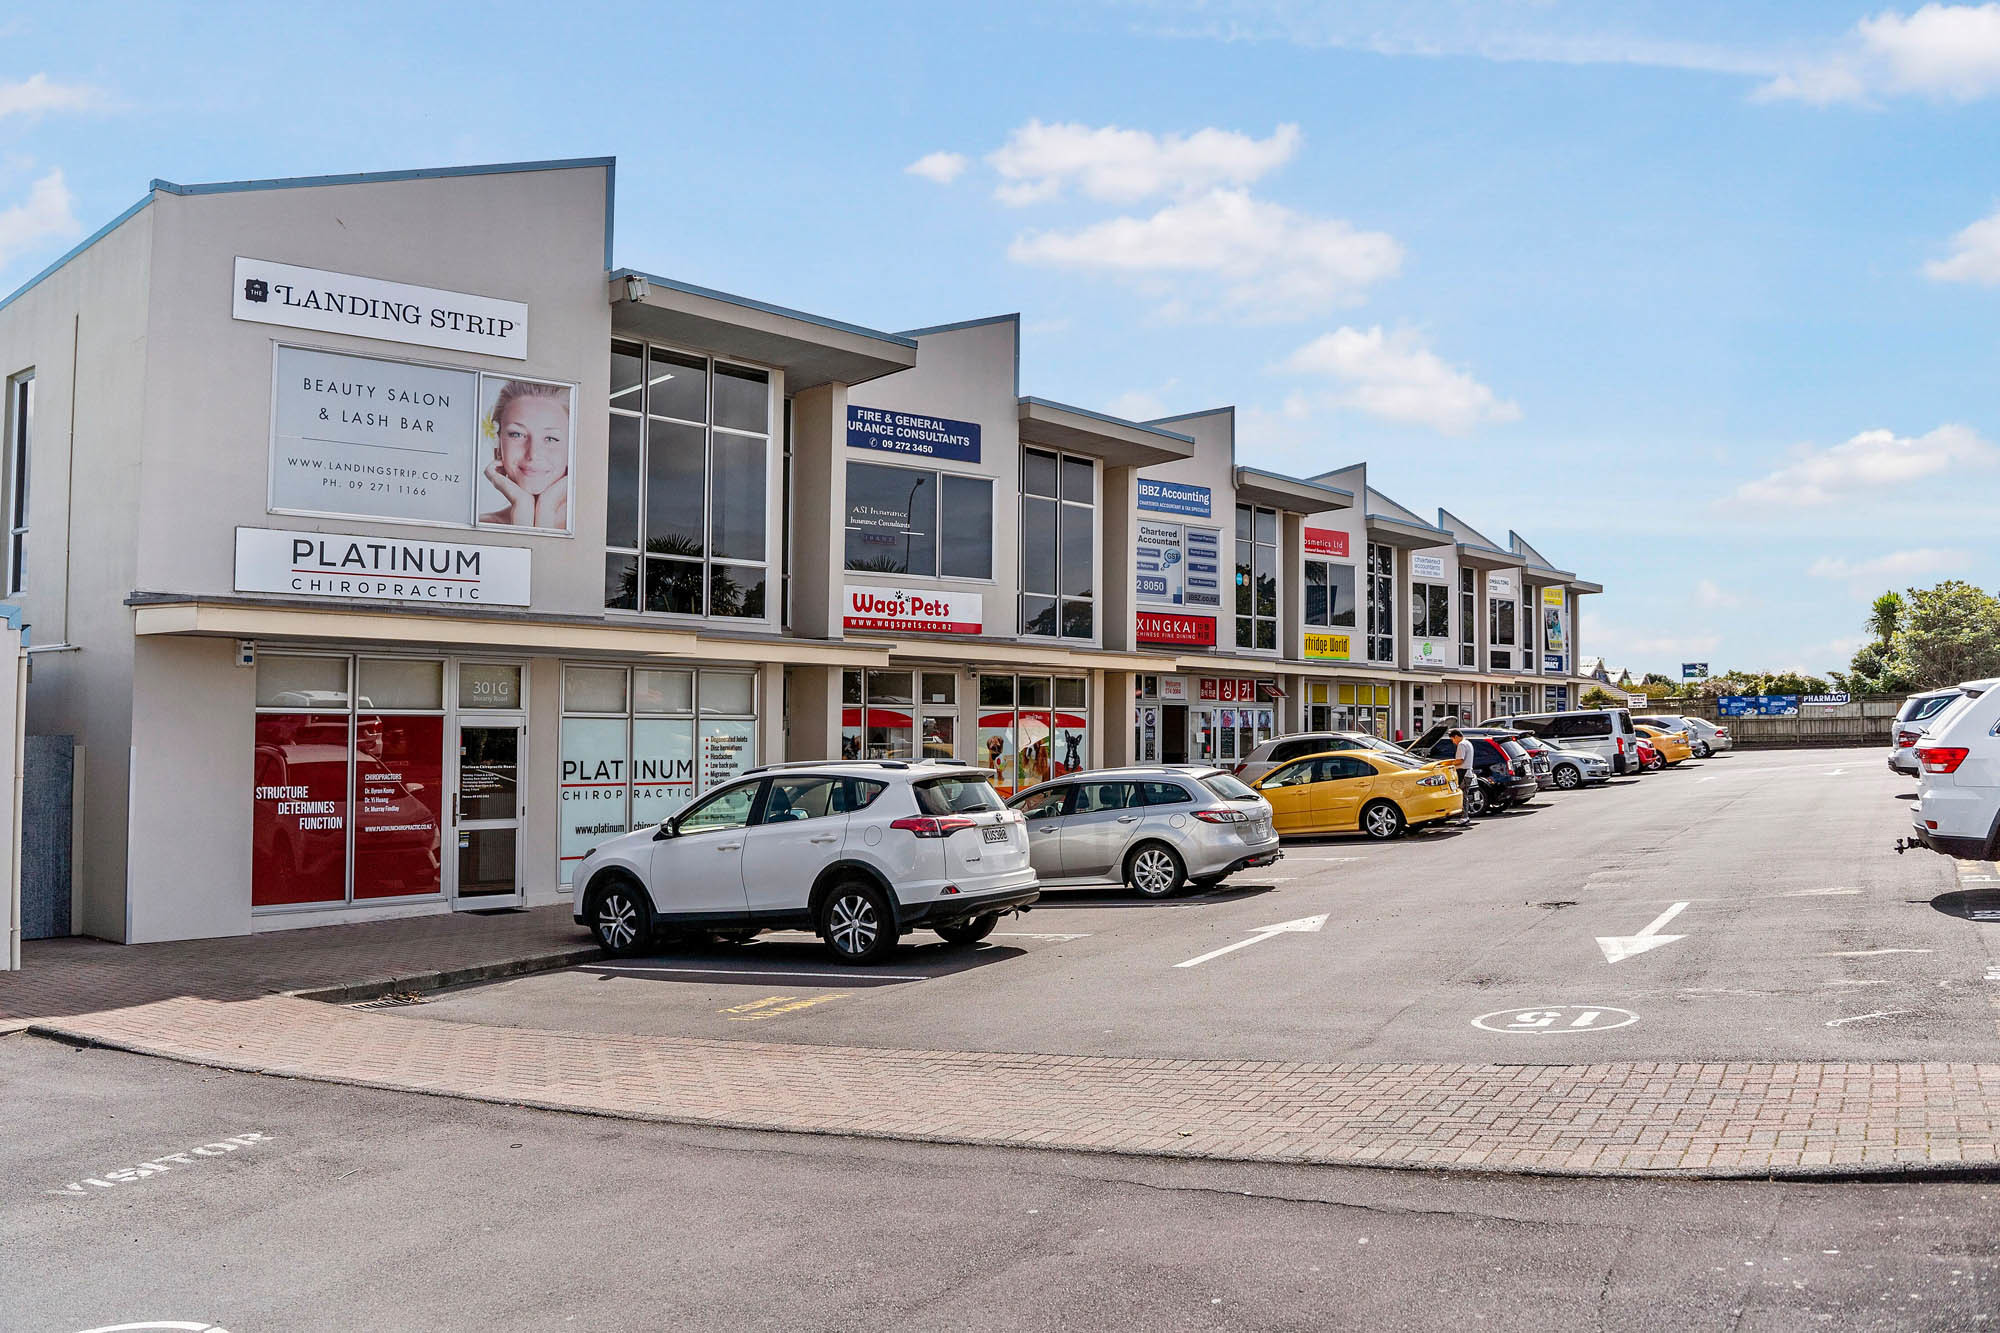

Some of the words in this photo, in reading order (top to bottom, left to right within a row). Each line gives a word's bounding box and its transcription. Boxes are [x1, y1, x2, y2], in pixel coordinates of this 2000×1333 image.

[250, 289, 263, 297] THE
[274, 284, 422, 325] LANDING
[430, 308, 515, 339] STRIP
[303, 377, 376, 398] BEAUTY
[387, 388, 451, 408] SALON
[318, 408, 329, 421] &
[341, 410, 389, 428] LASH
[400, 417, 435, 433] BAR
[857, 409, 882, 422] FIRE
[884, 413, 893, 424] &
[895, 415, 945, 431] GENERAL
[847, 420, 894, 436] URANCE
[896, 427, 970, 447] CONSULTANTS
[882, 439, 893, 448] 09
[895, 441, 911, 451] 272
[912, 443, 933, 454] 3450
[287, 457, 460, 483] WWW.LANDINGSTRIP.CO.NZ
[322, 478, 342, 488] PH.
[349, 480, 363, 489] 09
[370, 482, 391, 493] 271
[399, 485, 427, 496] 1166
[1139, 484, 1160, 497] IBBZ
[1161, 487, 1210, 505] Accounting
[853, 506, 867, 514] ASI
[871, 507, 908, 518] Insurance
[850, 516, 877, 526] Insurance
[878, 519, 911, 528] Consultants
[1140, 526, 1177, 538] Chartered
[1137, 535, 1180, 547] Accountant
[292, 538, 481, 576] PLATINUM
[1167, 552, 1179, 560] GST
[291, 577, 480, 600] CHIROPRACTIC
[1143, 580, 1164, 591] 8050
[852, 592, 905, 617] Wags
[911, 596, 950, 617] Pets
[850, 618, 952, 631] www.wagspets.co.nz
[1136, 618, 1196, 634] XINGKAI
[1329, 637, 1347, 653] World
[473, 681, 508, 695] 301G
[1803, 694, 1847, 702] PHARMACY
[562, 759, 693, 781] PLATINUM
[729, 762, 738, 771] pain
[256, 785, 309, 800] STRUCTURE
[562, 787, 692, 801] CHIROPRACTIC
[278, 801, 335, 816] DETERMINES
[299, 817, 343, 830] FUNCTION
[48, 1131, 275, 1195] VISITOR
